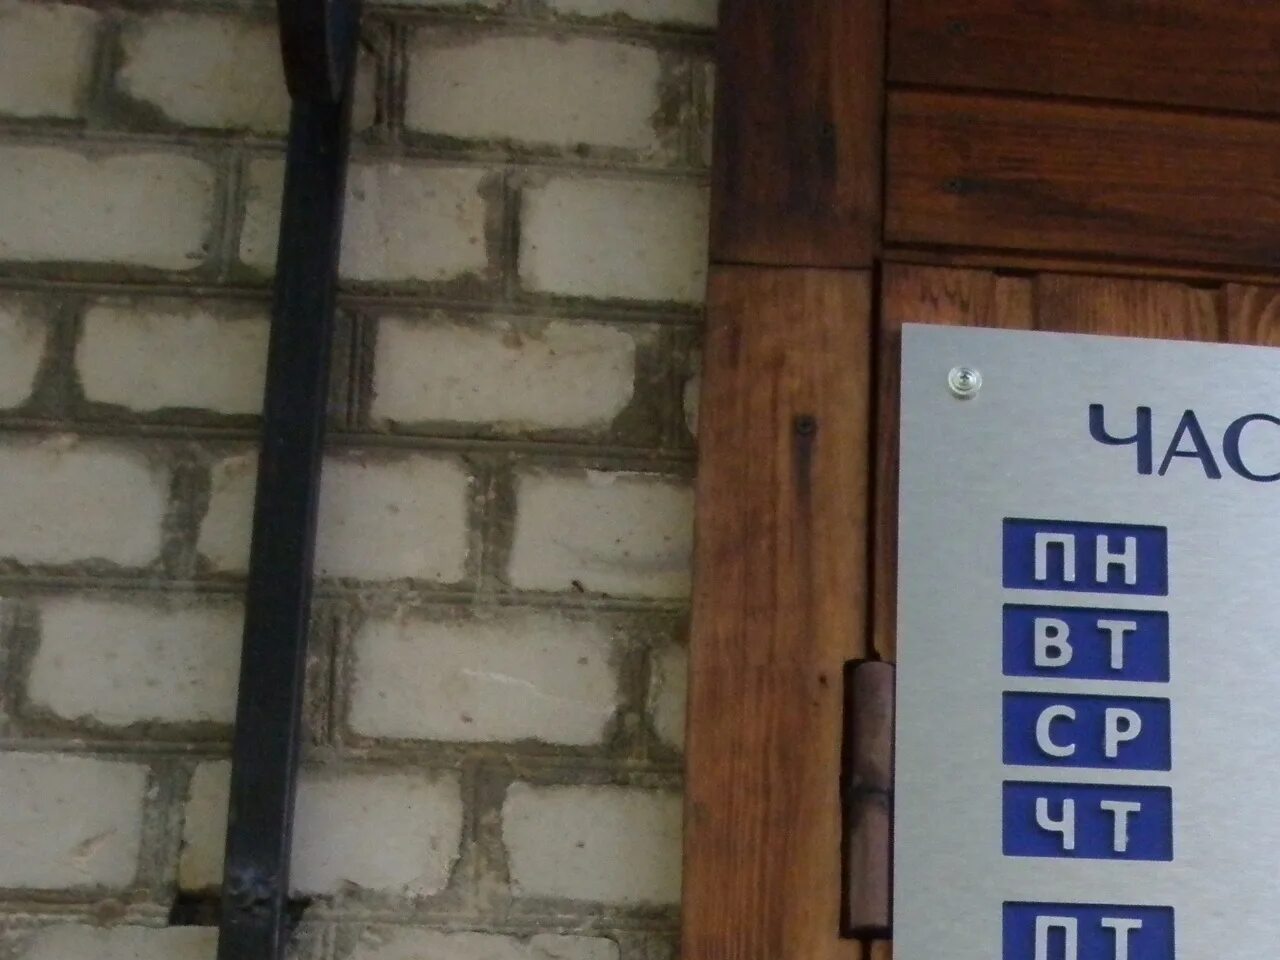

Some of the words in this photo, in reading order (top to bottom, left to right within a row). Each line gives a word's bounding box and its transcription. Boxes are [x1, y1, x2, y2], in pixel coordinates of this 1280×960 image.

[1034, 532, 1138, 585] ПН
[1034, 617, 1138, 670] ВТ
[1035, 704, 1143, 758] СР
[1035, 797, 1142, 853] ЧТ
